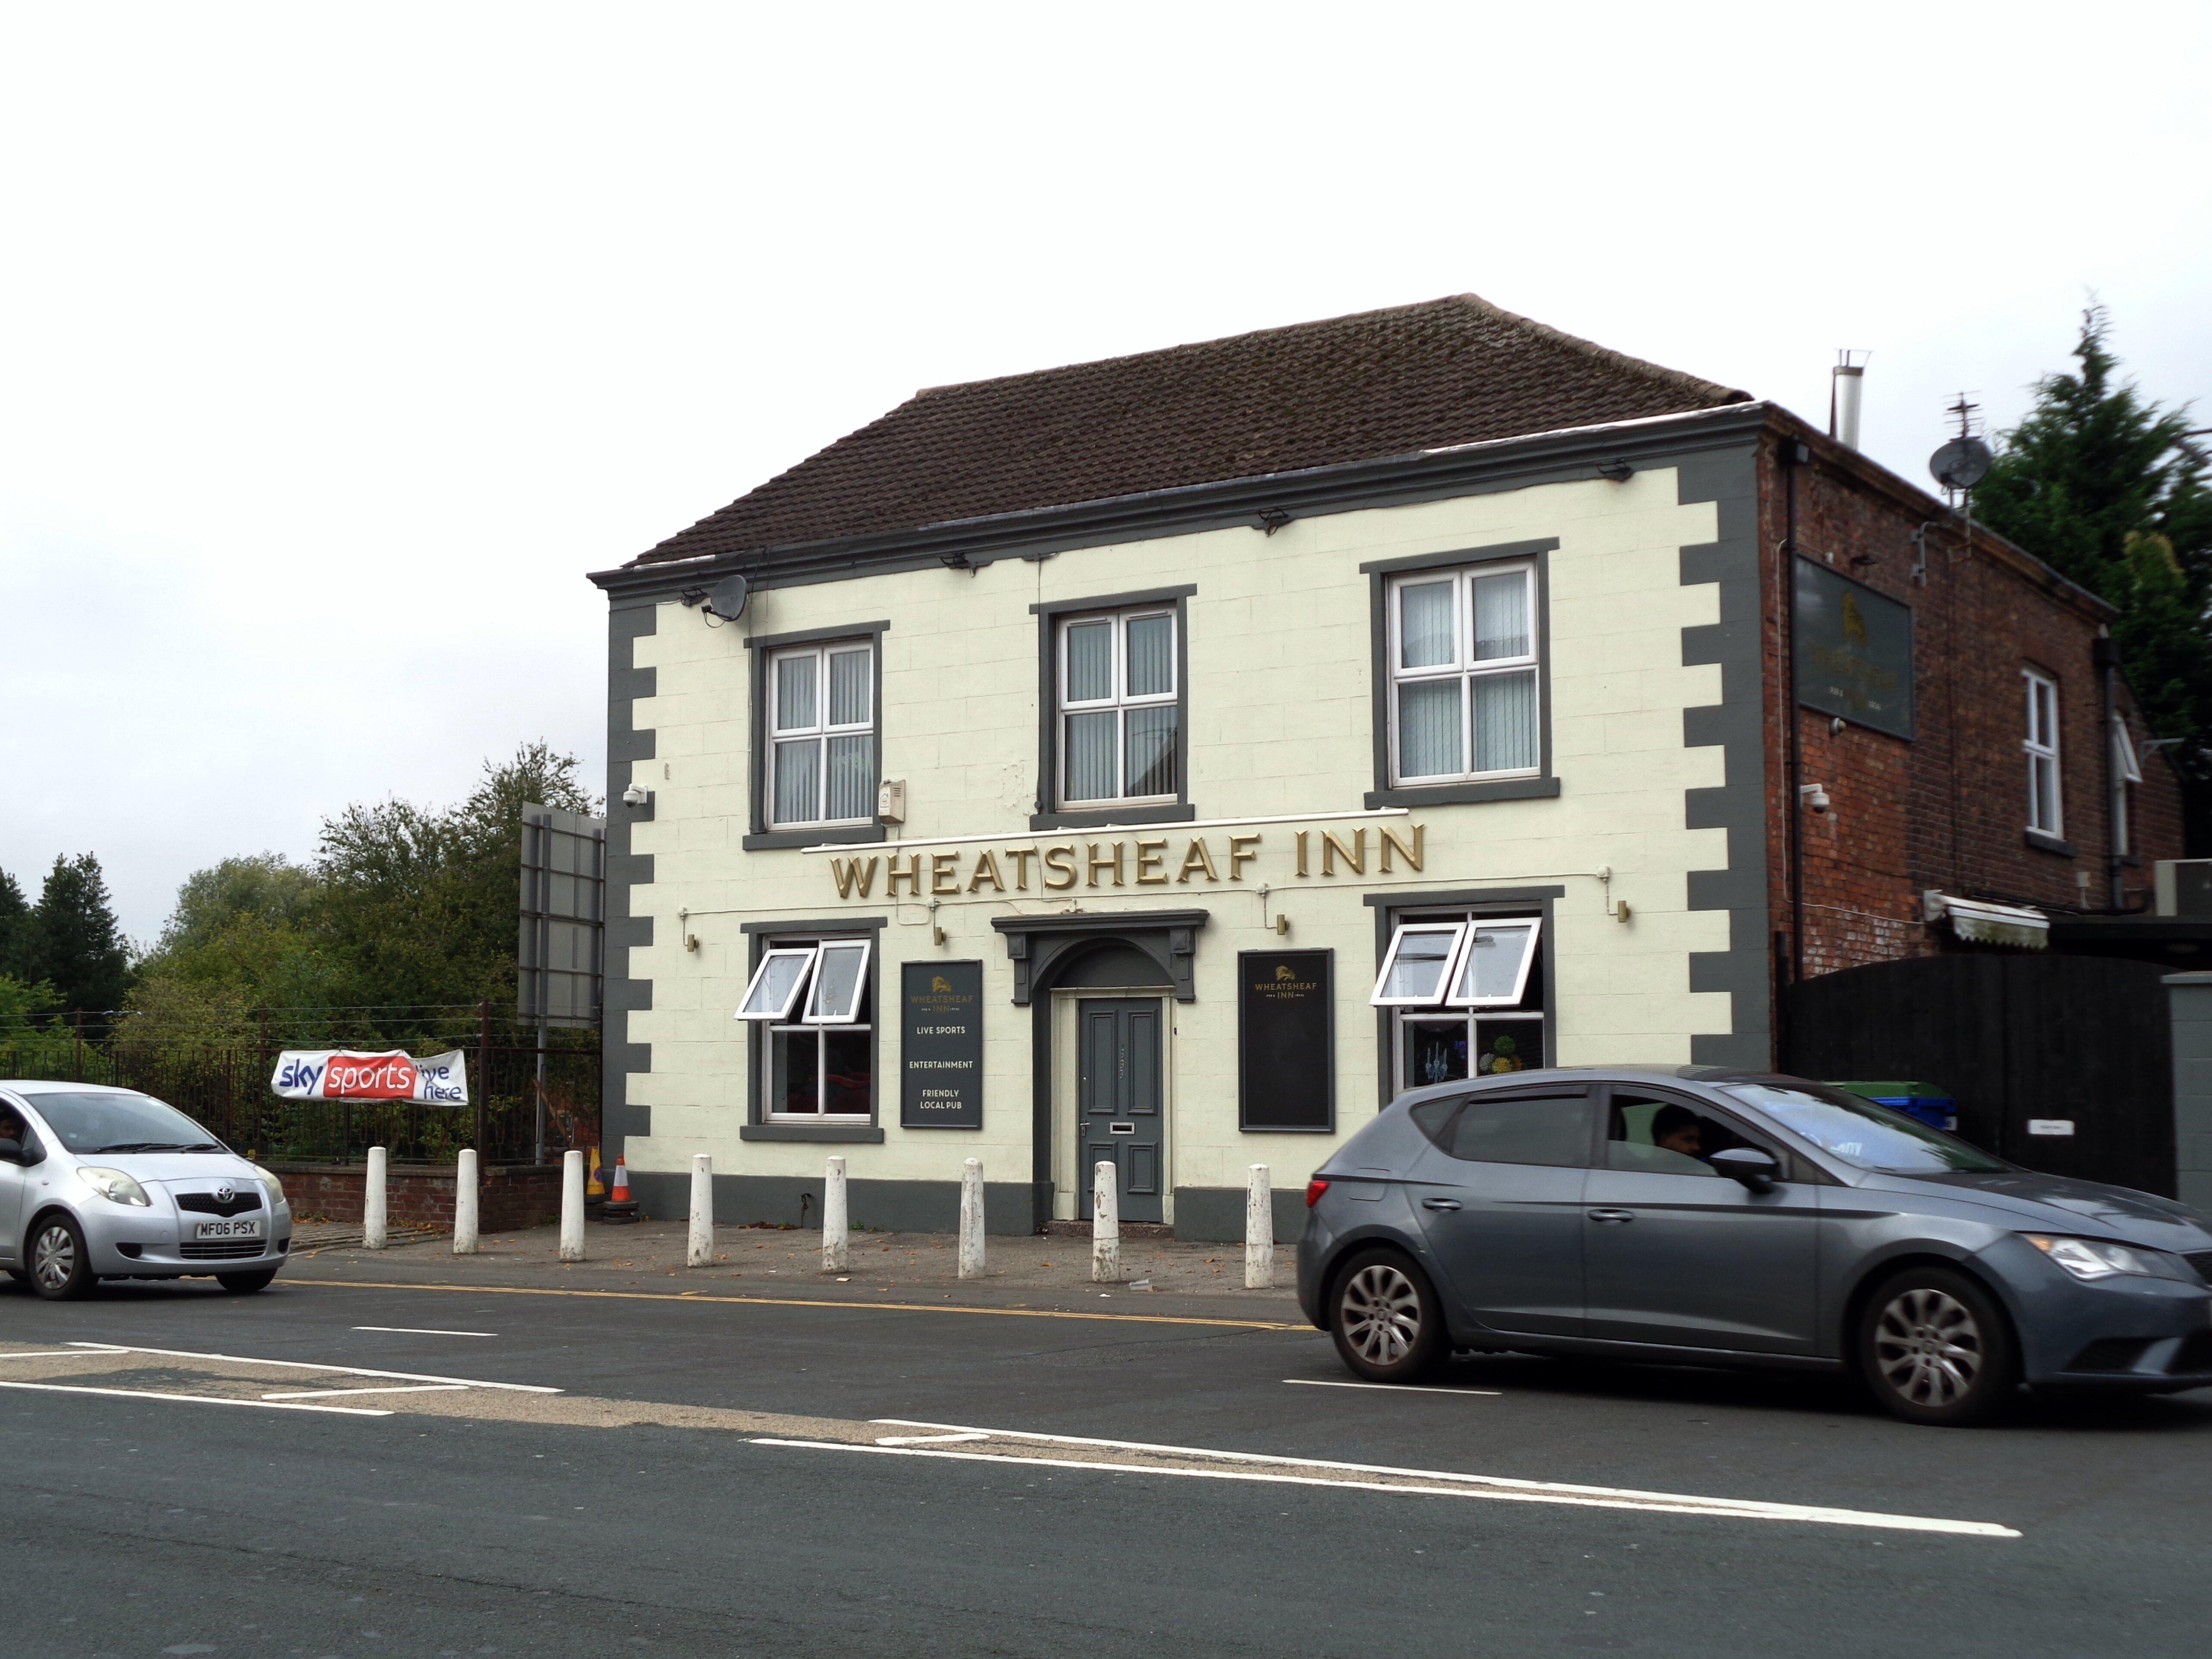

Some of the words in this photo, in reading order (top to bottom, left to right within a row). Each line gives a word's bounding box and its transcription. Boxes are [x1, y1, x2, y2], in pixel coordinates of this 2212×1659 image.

[830, 833, 1262, 899] WHEATSHEAF
[1294, 824, 1425, 877] INN
[910, 995, 974, 1003] WHEATSHEAF
[917, 1026, 933, 1034] LIVE
[936, 1026, 965, 1034] SPORTS
[909, 1060, 973, 1068] ENTERTAINMENT
[279, 1058, 324, 1095] sky
[328, 1062, 411, 1094] sports
[424, 1081, 462, 1100] here
[922, 1089, 959, 1097] FRIENDLY
[201, 1222, 230, 1235] MF06
[233, 1221, 255, 1235] PSX
